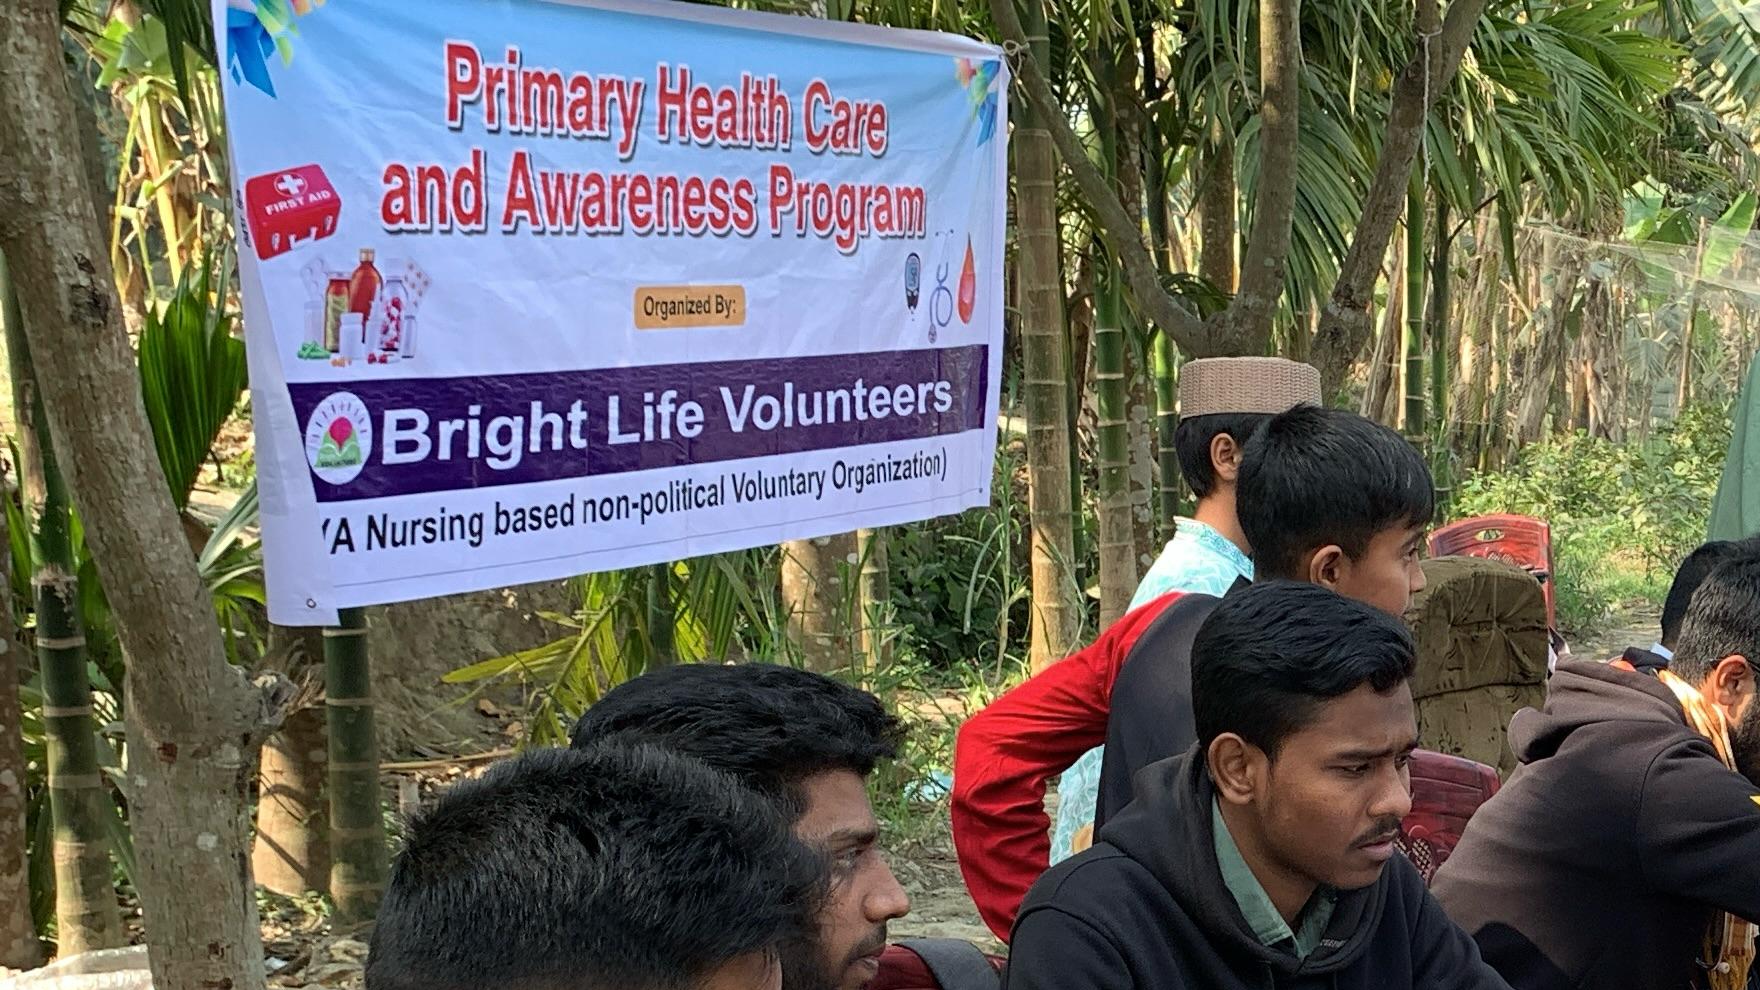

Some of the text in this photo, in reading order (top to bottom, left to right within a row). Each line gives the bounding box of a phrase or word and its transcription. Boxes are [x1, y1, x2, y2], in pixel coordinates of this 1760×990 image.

[445, 40, 888, 158] Primary Health Care
[265, 190, 331, 215] FIRST AID
[381, 148, 926, 253] and Awareness Program
[643, 294, 736, 320] Organized By:
[382, 378, 953, 470] Bright Life Volunteers
[366, 507, 484, 551] Nursing
[494, 493, 574, 535] based
[583, 475, 725, 524] non-political
[731, 467, 826, 501] Voluntary
[832, 447, 947, 493] Organization)
